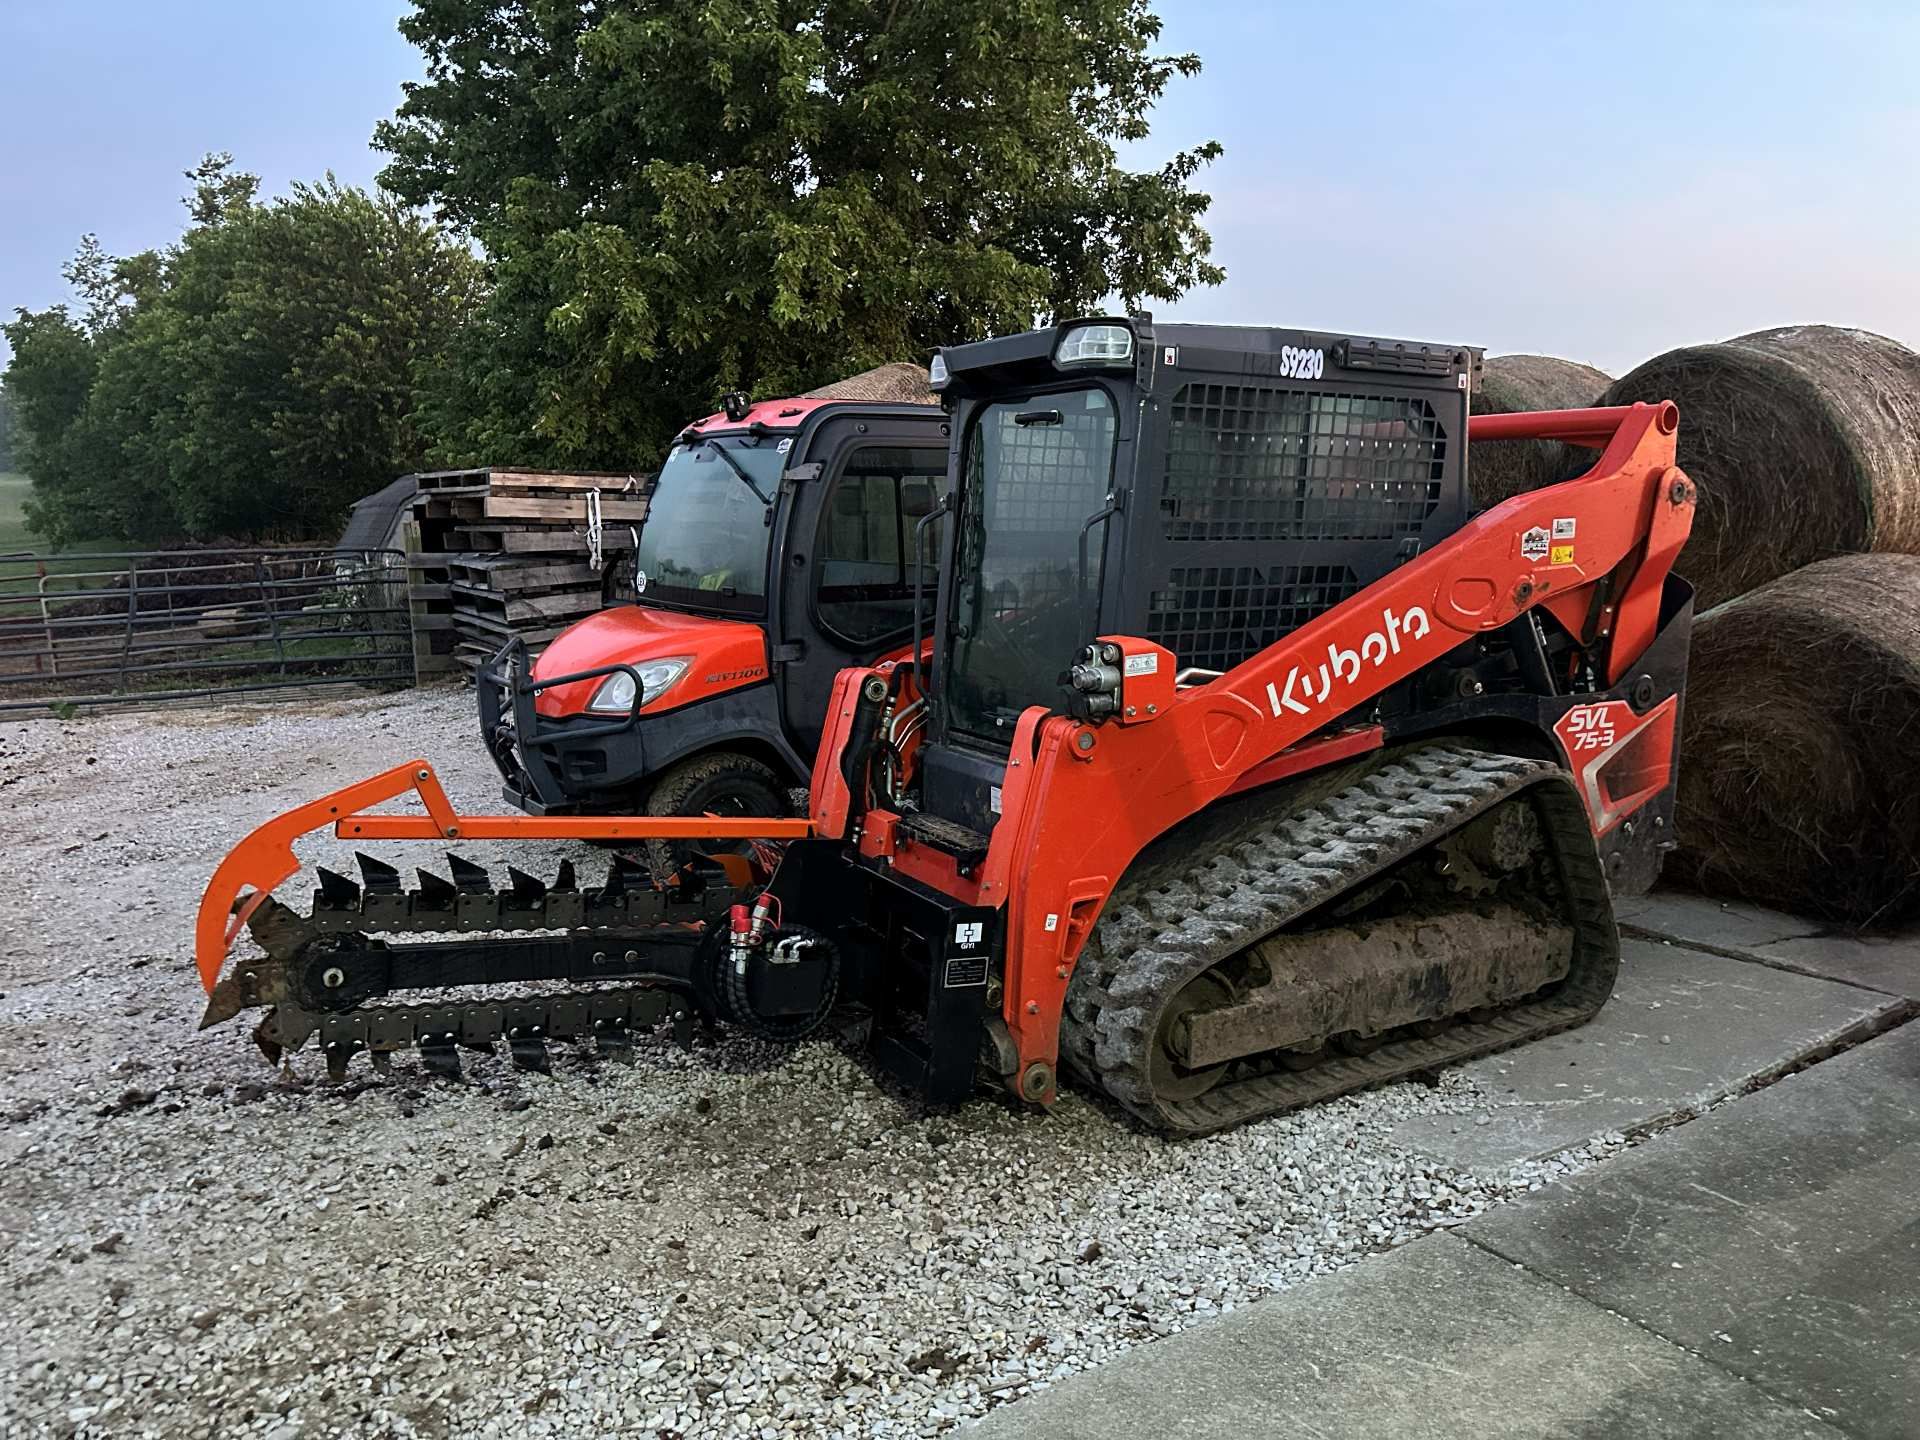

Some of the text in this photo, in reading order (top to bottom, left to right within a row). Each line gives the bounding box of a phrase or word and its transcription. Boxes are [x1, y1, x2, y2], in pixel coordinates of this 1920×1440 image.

[1280, 345, 1324, 380] S9230
[1266, 606, 1431, 718] Kubota
[1567, 707, 1614, 732] SVL
[1574, 729, 1615, 751] 75-3
